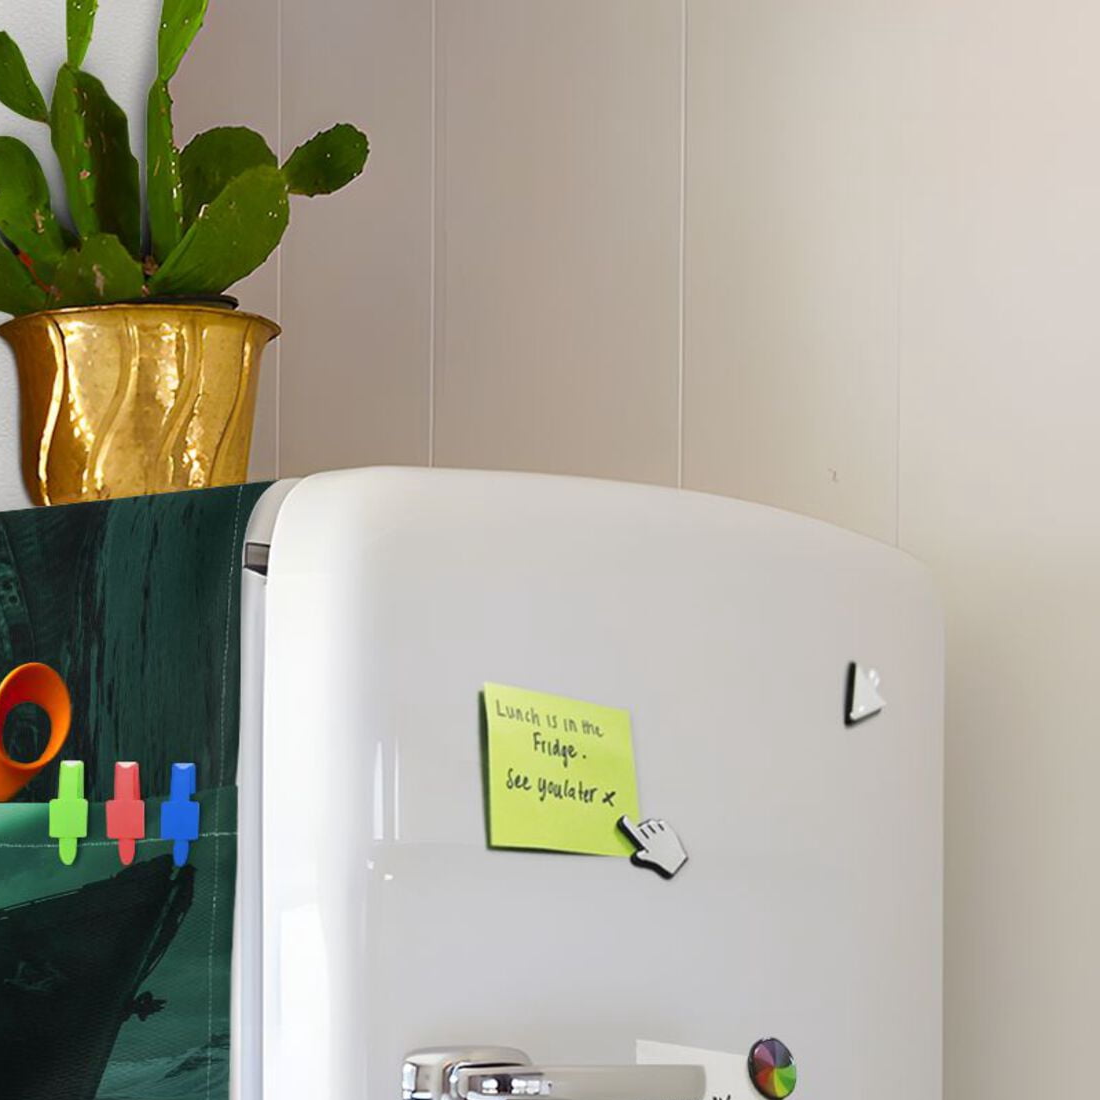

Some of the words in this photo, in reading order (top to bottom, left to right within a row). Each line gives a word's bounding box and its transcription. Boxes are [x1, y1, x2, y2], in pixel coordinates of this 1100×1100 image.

[495, 699, 540, 728] Lunch
[546, 714, 558, 730] is
[563, 718, 578, 733] in
[582, 719, 604, 738] the
[506, 767, 532, 791] See
